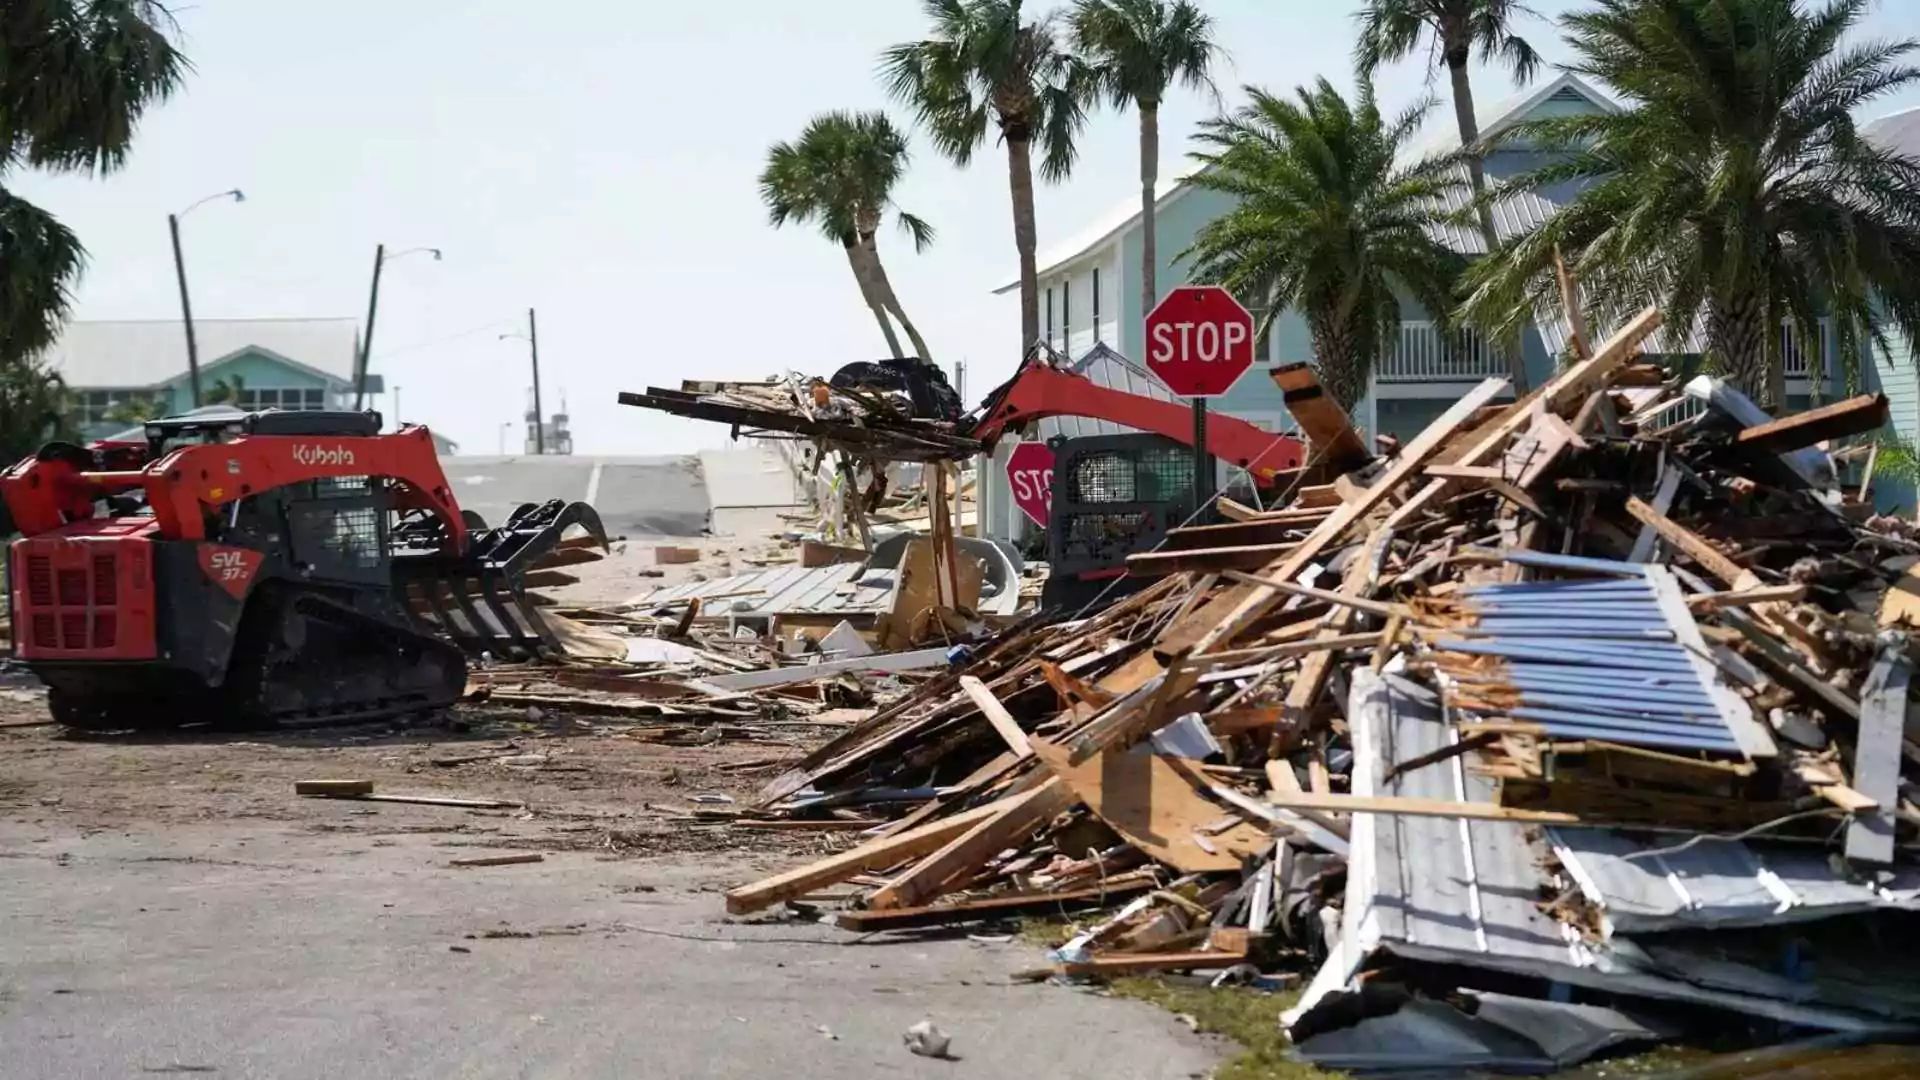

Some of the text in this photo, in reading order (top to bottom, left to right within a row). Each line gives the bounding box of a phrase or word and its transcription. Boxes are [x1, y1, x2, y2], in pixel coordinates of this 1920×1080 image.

[1152, 321, 1246, 363] STOP
[292, 443, 354, 465] Kubota
[1014, 468, 1054, 501] STO
[209, 551, 247, 568] SVL
